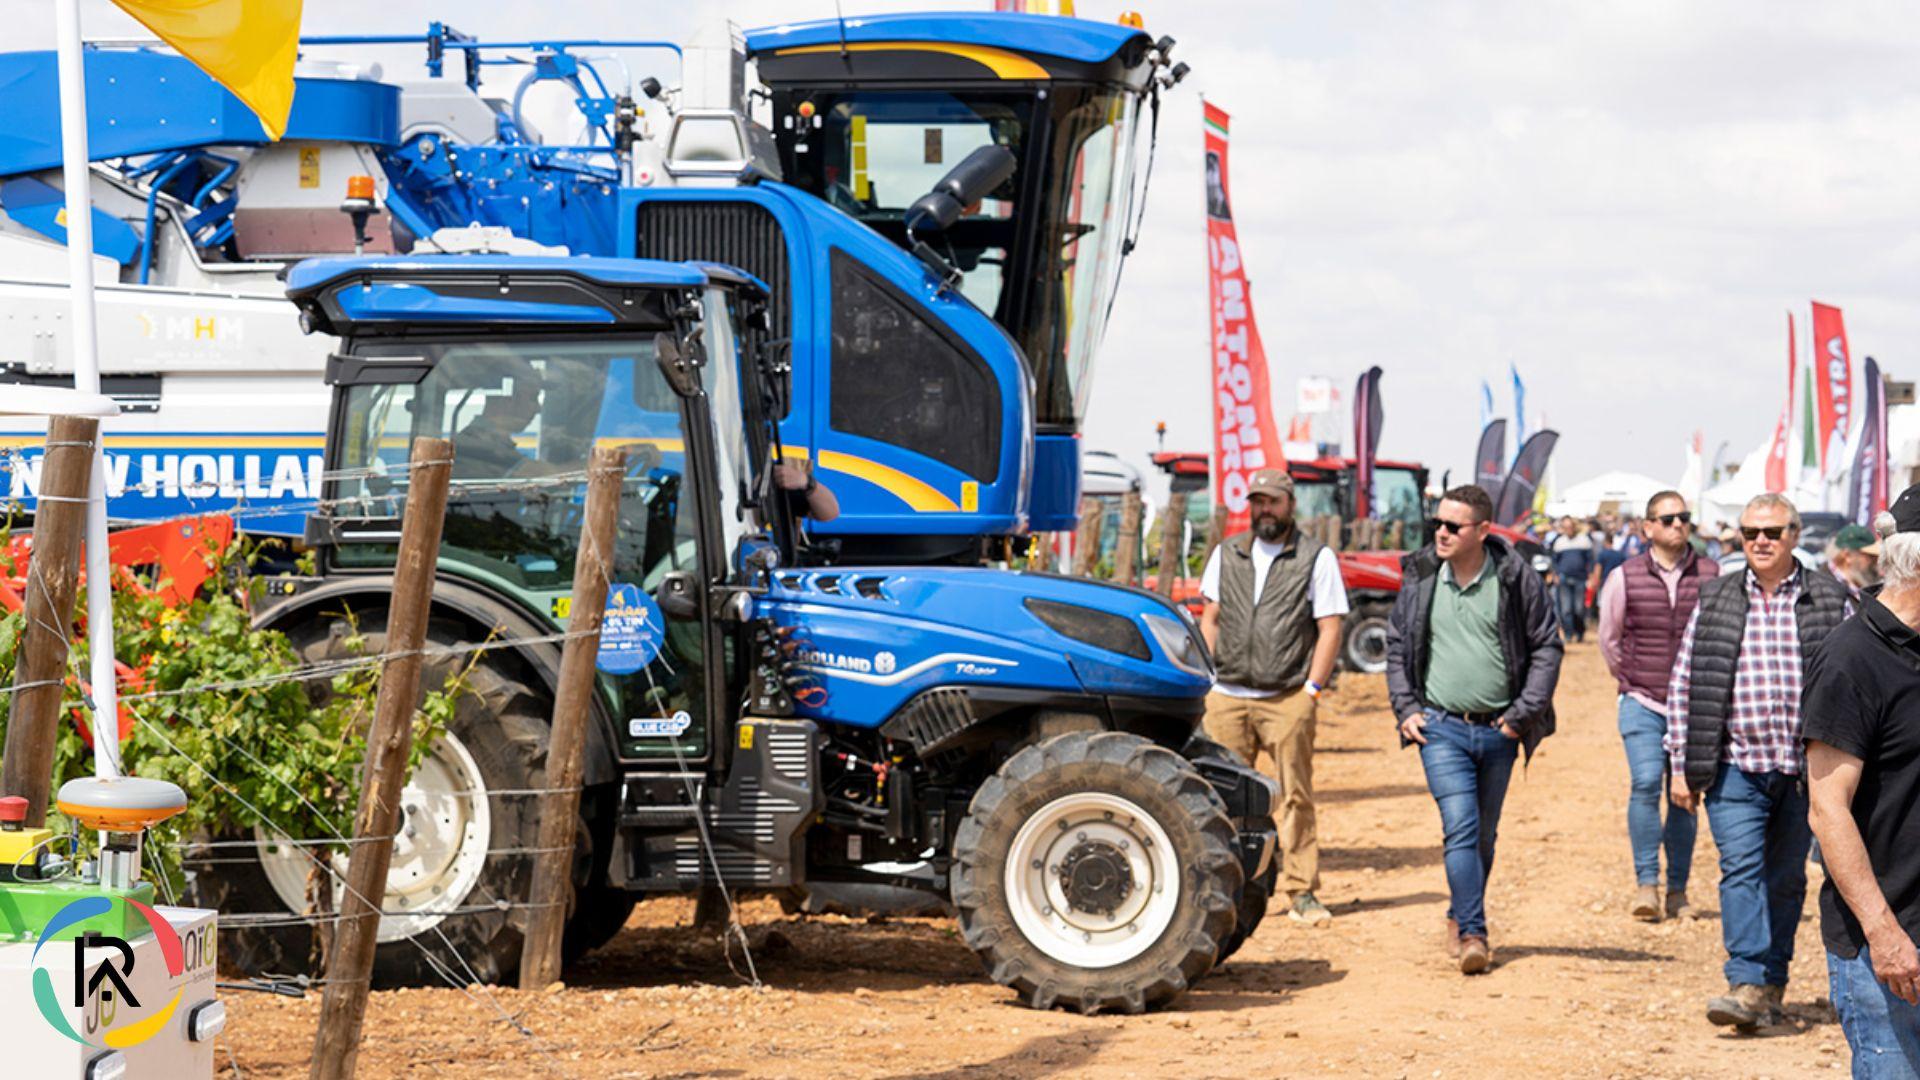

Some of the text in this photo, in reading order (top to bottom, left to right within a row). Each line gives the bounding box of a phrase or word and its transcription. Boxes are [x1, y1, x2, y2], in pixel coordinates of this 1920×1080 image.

[166, 316, 243, 341] MHM
[1219, 235, 1266, 489] ANTONI
[10, 455, 324, 499] NW HOLLA
